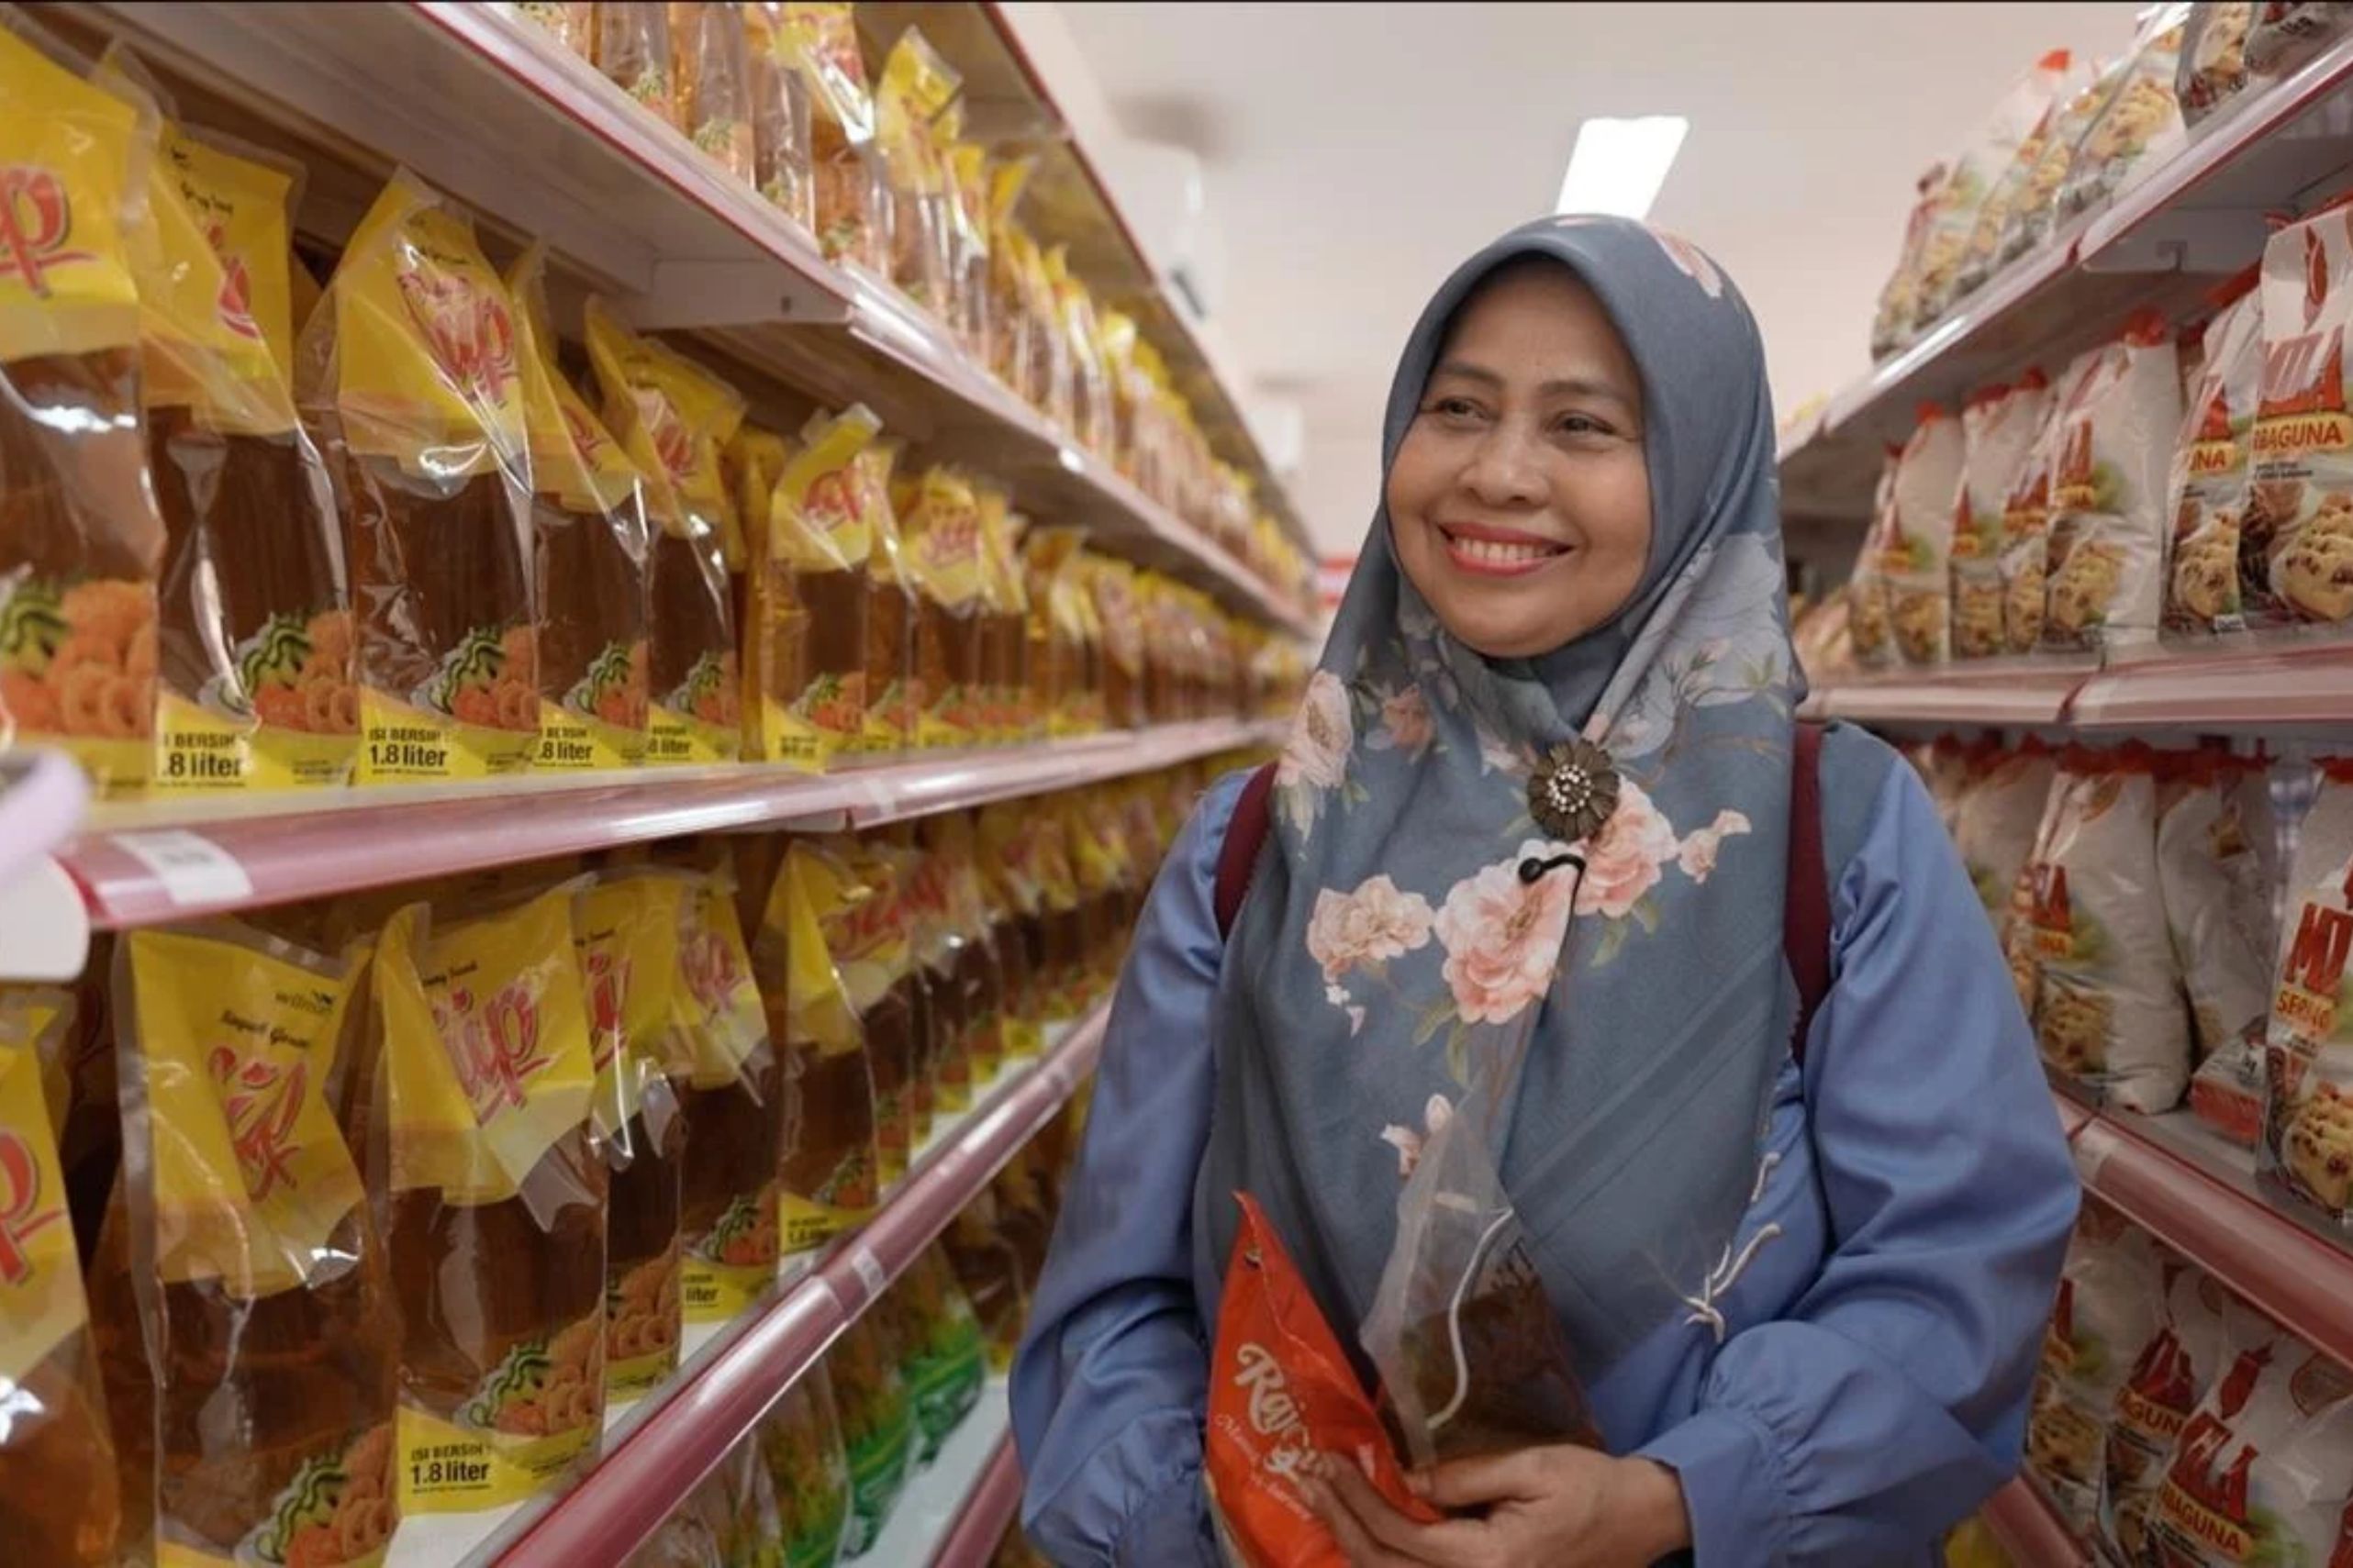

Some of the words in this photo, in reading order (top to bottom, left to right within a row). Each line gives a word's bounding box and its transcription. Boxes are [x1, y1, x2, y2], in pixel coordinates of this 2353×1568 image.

[370, 744, 399, 765] 1.8
[403, 744, 448, 767] liter
[540, 740, 554, 760] .8
[557, 741, 594, 761] liter
[163, 751, 185, 778] .8
[191, 752, 240, 778] liter
[412, 1462, 442, 1485] 1.8
[446, 1460, 490, 1483] liter
